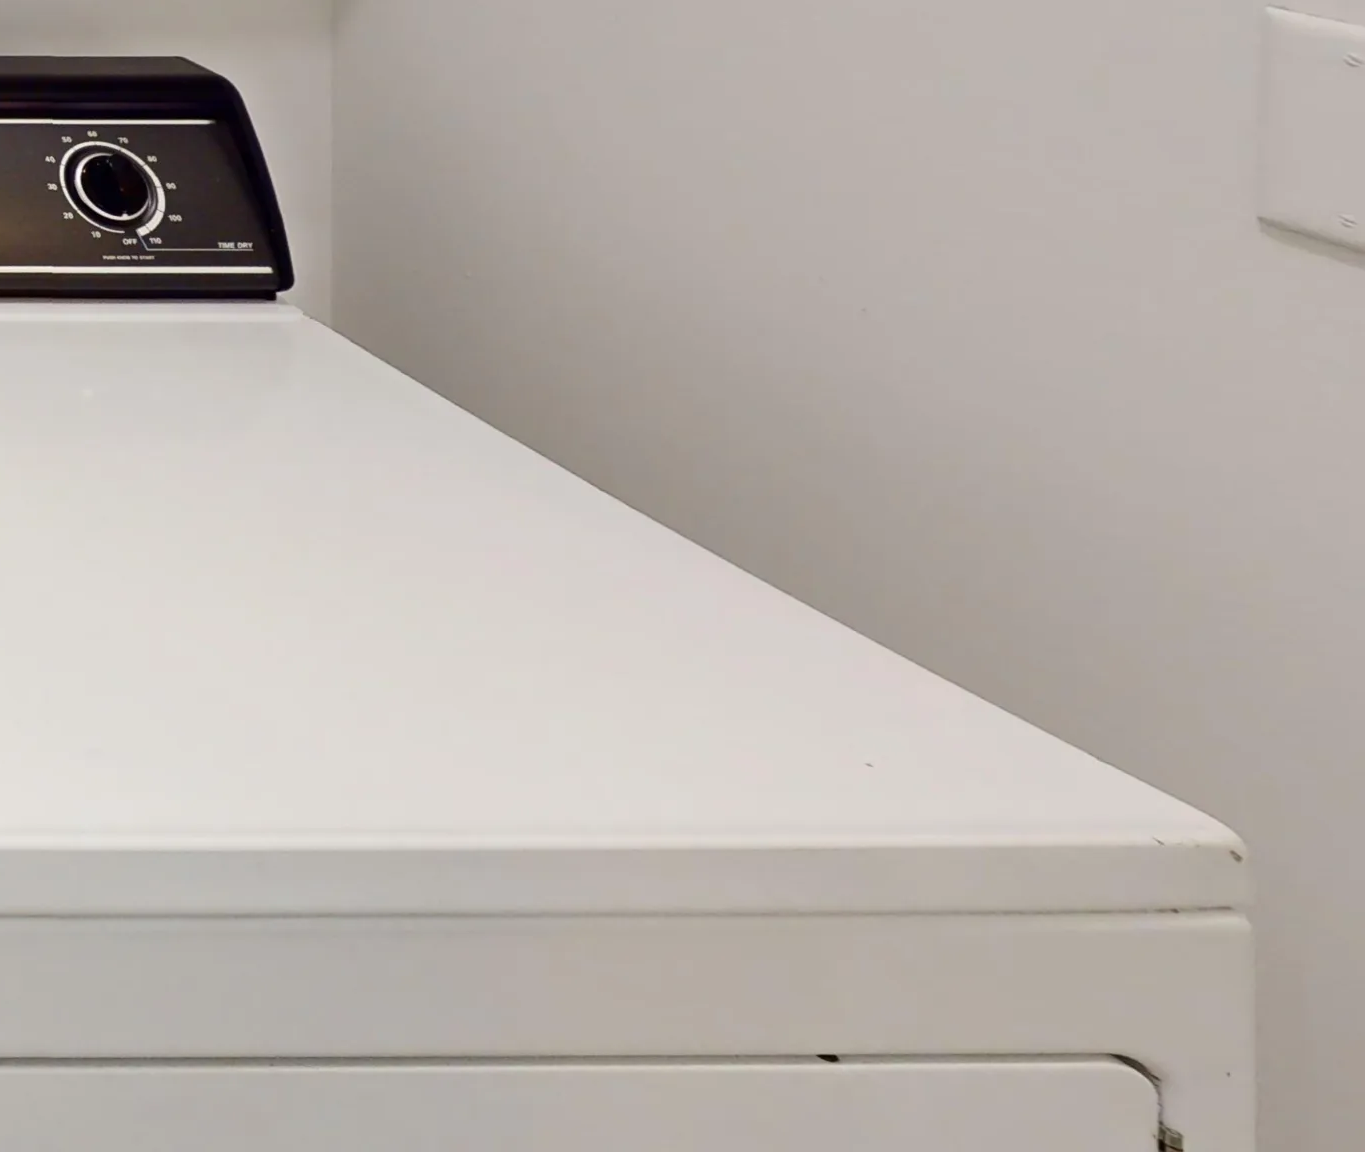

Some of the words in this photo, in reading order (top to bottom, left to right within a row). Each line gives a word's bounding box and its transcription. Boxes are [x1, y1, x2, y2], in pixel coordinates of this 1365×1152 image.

[168, 214, 183, 222] 100
[91, 231, 102, 239] 10
[122, 238, 138, 246] OFF
[149, 237, 162, 245] 110
[217, 241, 236, 249] TIME
